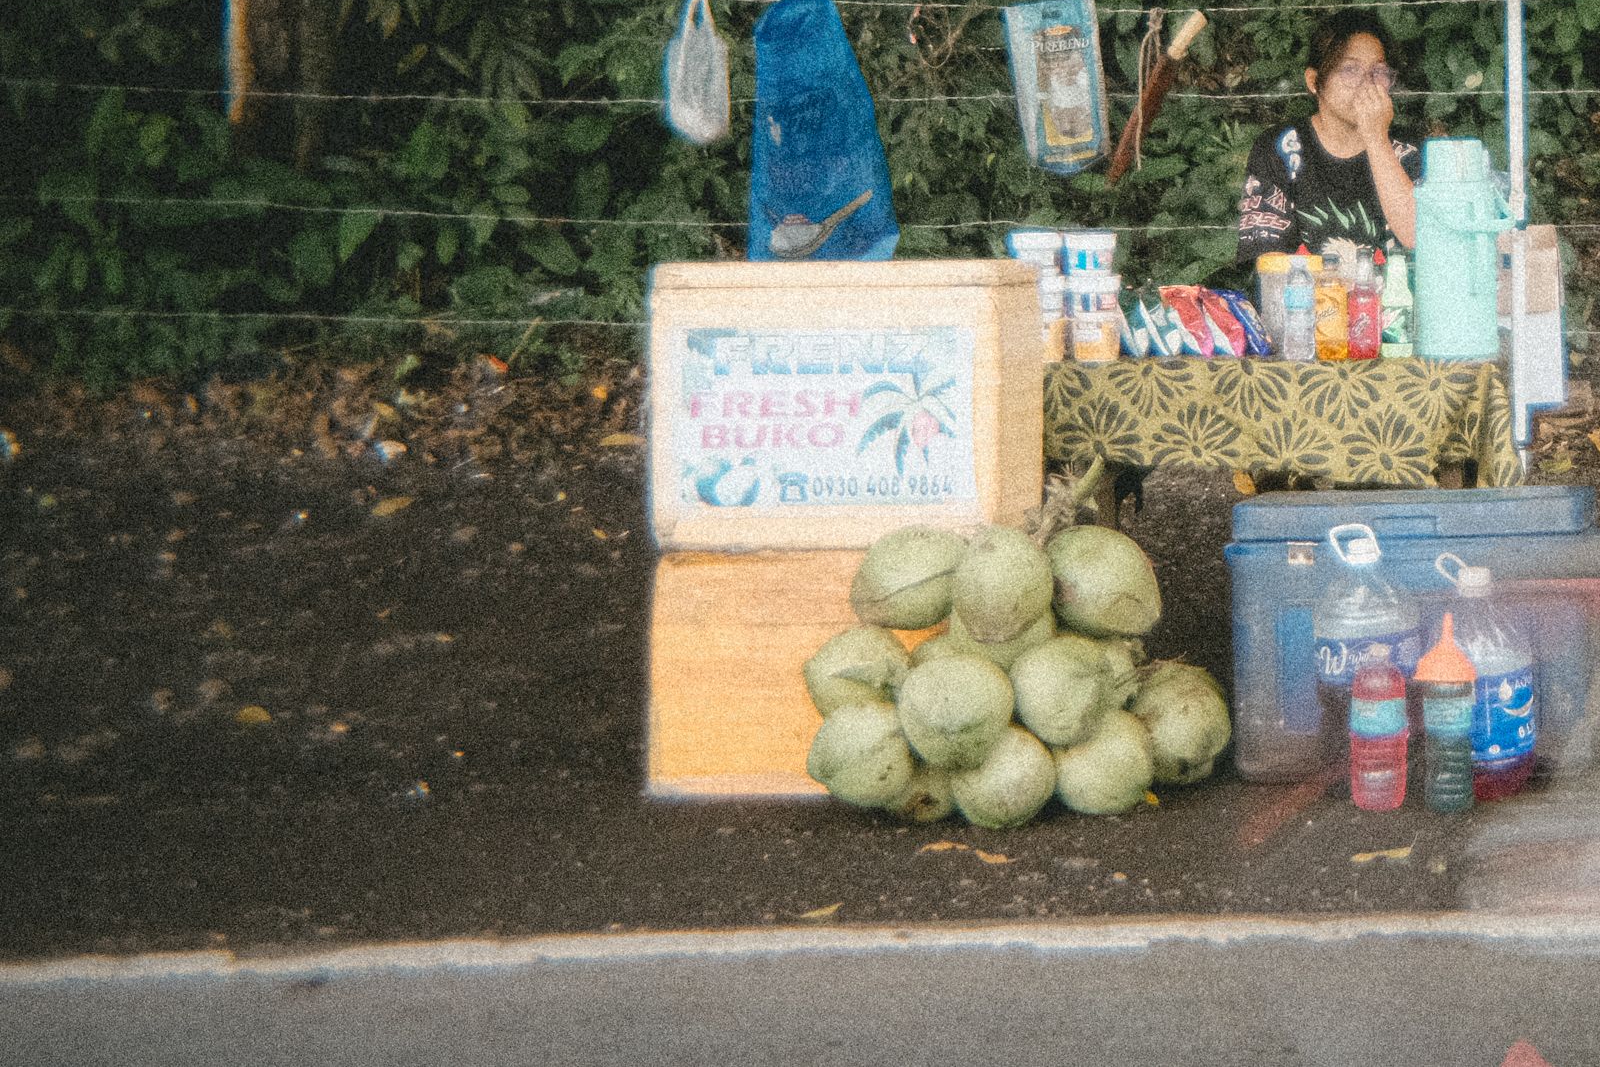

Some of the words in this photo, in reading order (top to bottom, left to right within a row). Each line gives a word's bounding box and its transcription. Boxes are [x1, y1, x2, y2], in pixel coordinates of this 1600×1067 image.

[690, 391, 861, 418] FRESH
[702, 424, 847, 449] BUKO
[812, 476, 858, 498] 0930
